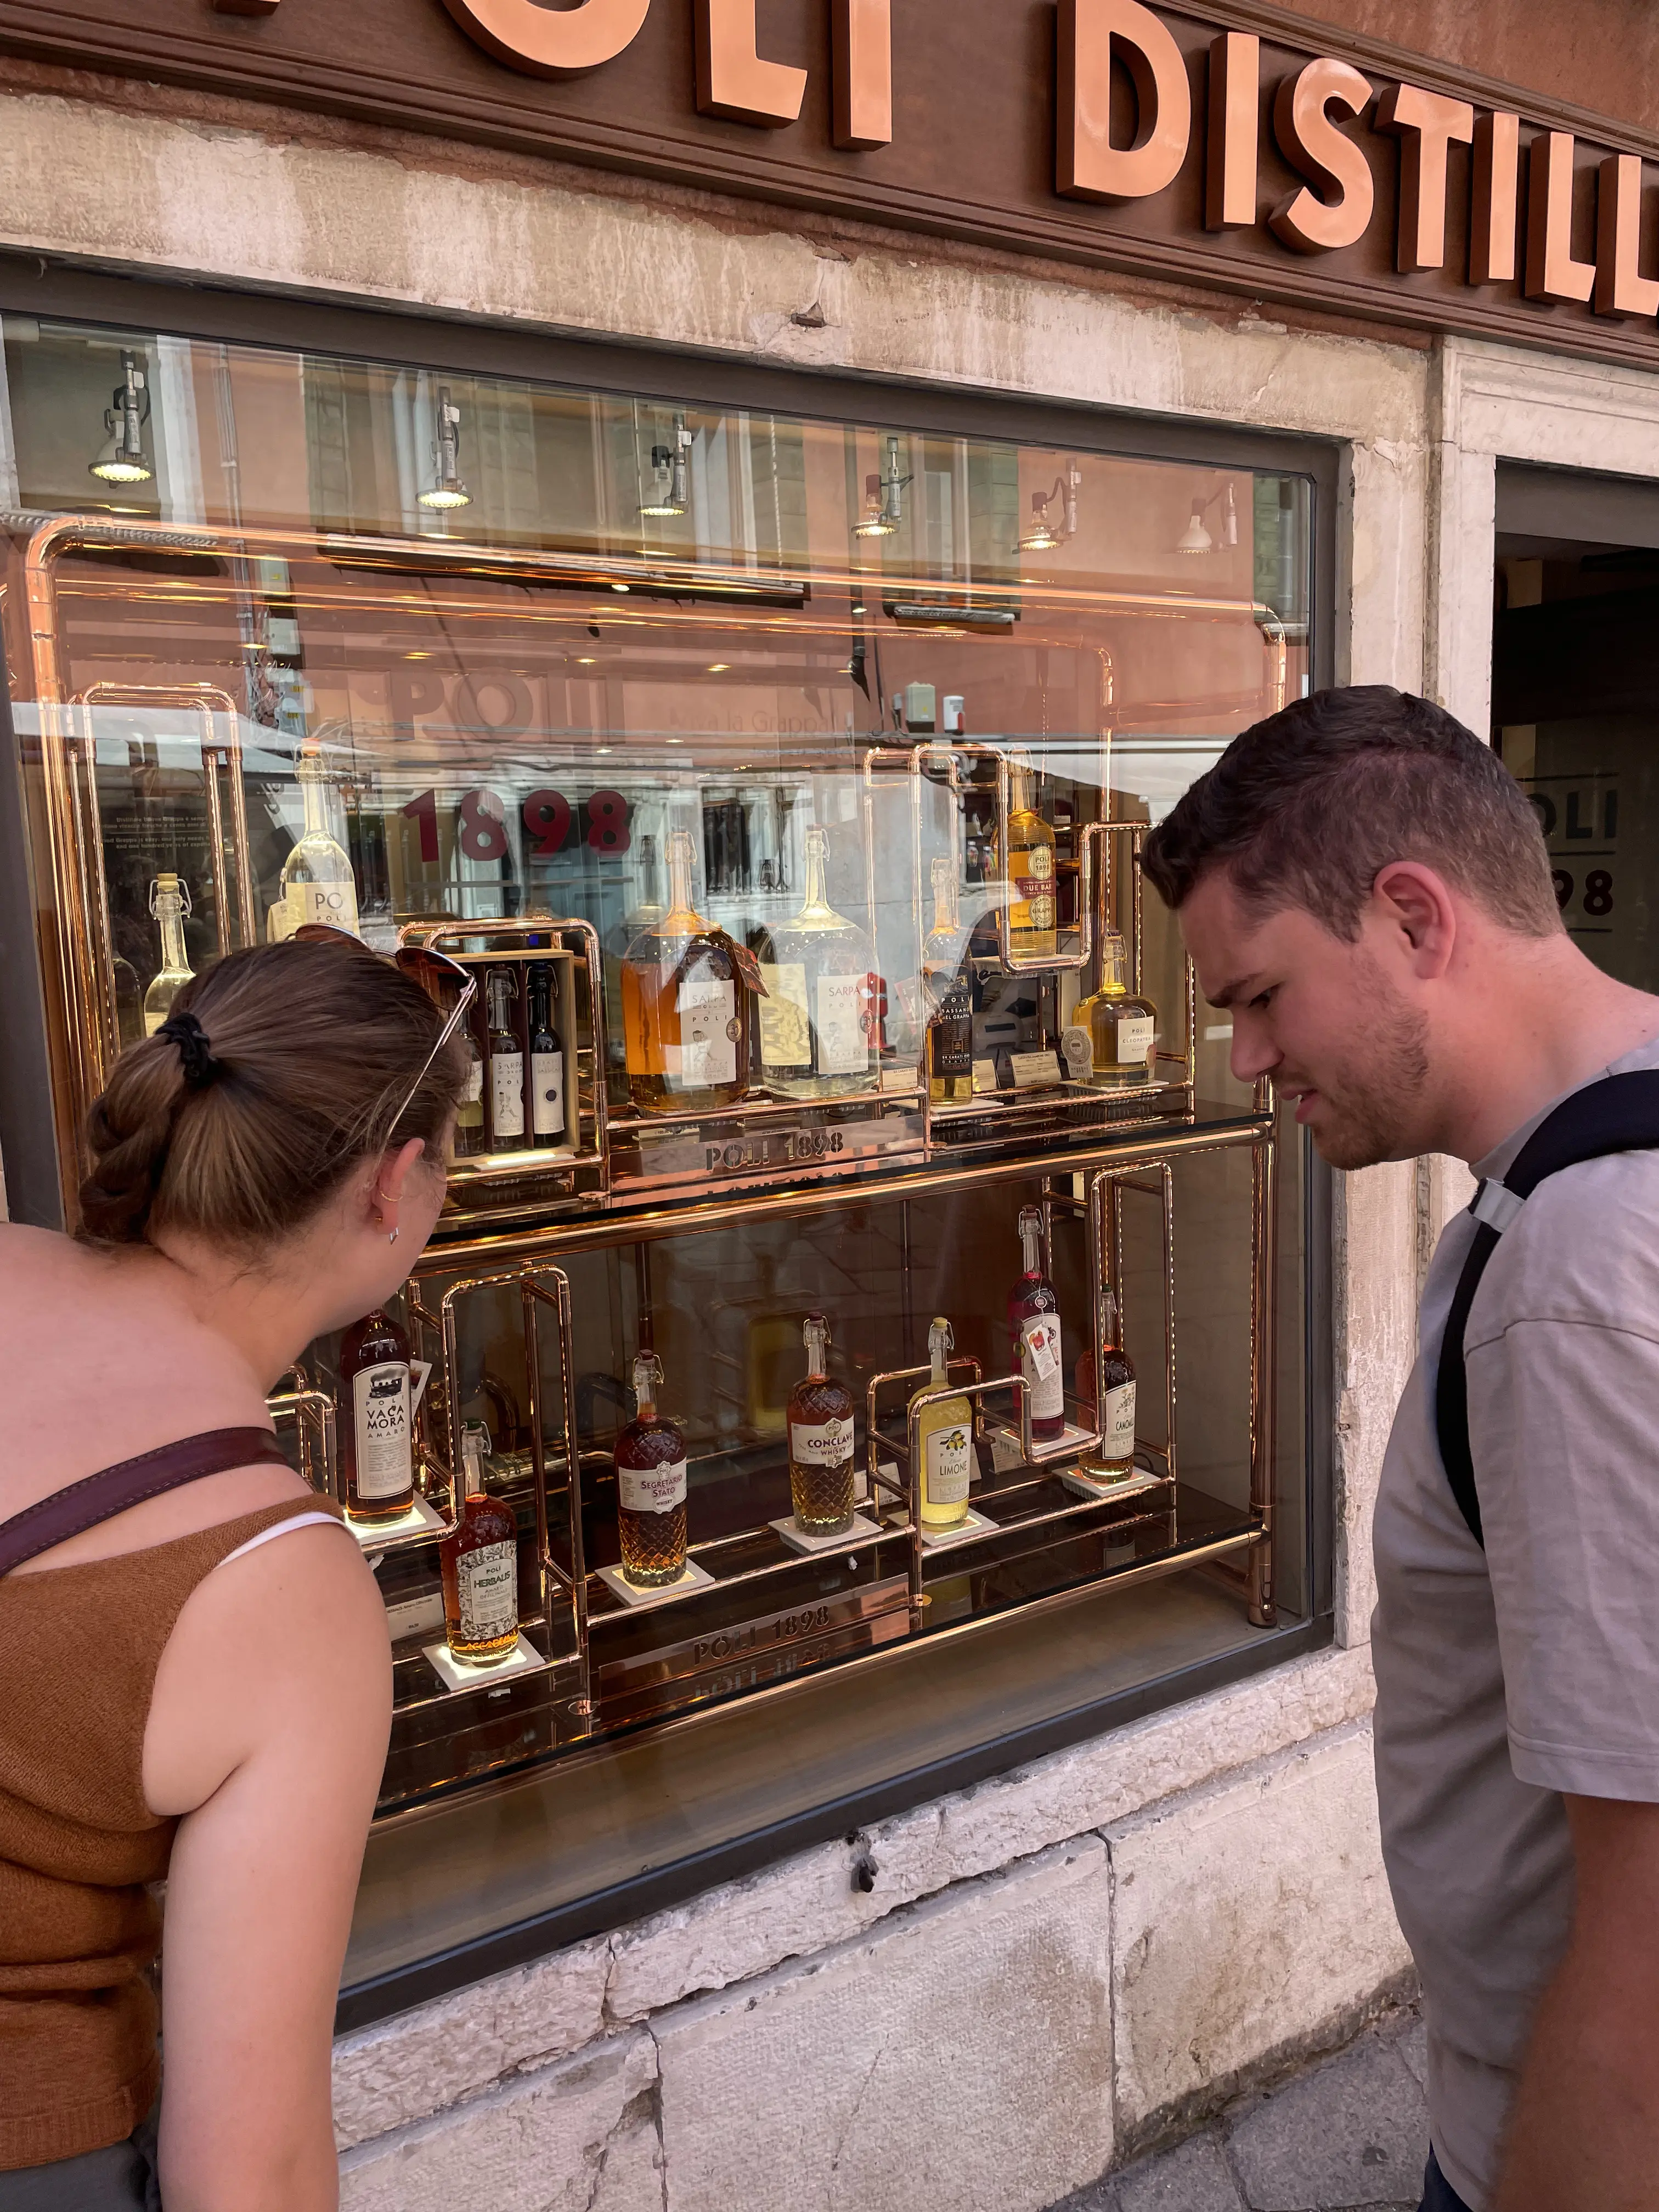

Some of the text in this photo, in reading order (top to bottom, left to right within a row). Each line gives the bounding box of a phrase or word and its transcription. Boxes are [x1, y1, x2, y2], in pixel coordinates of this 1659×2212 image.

[391, 665, 626, 745] POLI
[1525, 788, 1618, 839] OLI
[402, 788, 631, 863] 1898
[1551, 868, 1614, 917] 98
[828, 986, 861, 997] SARPA
[692, 1014, 727, 1023] POLI
[706, 1131, 844, 1171] POLI 1898
[365, 1395, 404, 1407] POLI
[366, 1414, 405, 1430] MORA
[367, 1426, 405, 1439] AMARO
[807, 1431, 853, 1448] CONCLAVE
[821, 1446, 846, 1456] WHISKY
[940, 1447, 968, 1458] POLI
[939, 1460, 968, 1476] LIMONE
[641, 1474, 683, 1489] SEGRETARIO
[652, 1487, 676, 1498] STATO
[486, 1565, 501, 1575] POLI
[473, 1570, 511, 1589] HERBALIS
[693, 1605, 830, 1667] POLI 1898
